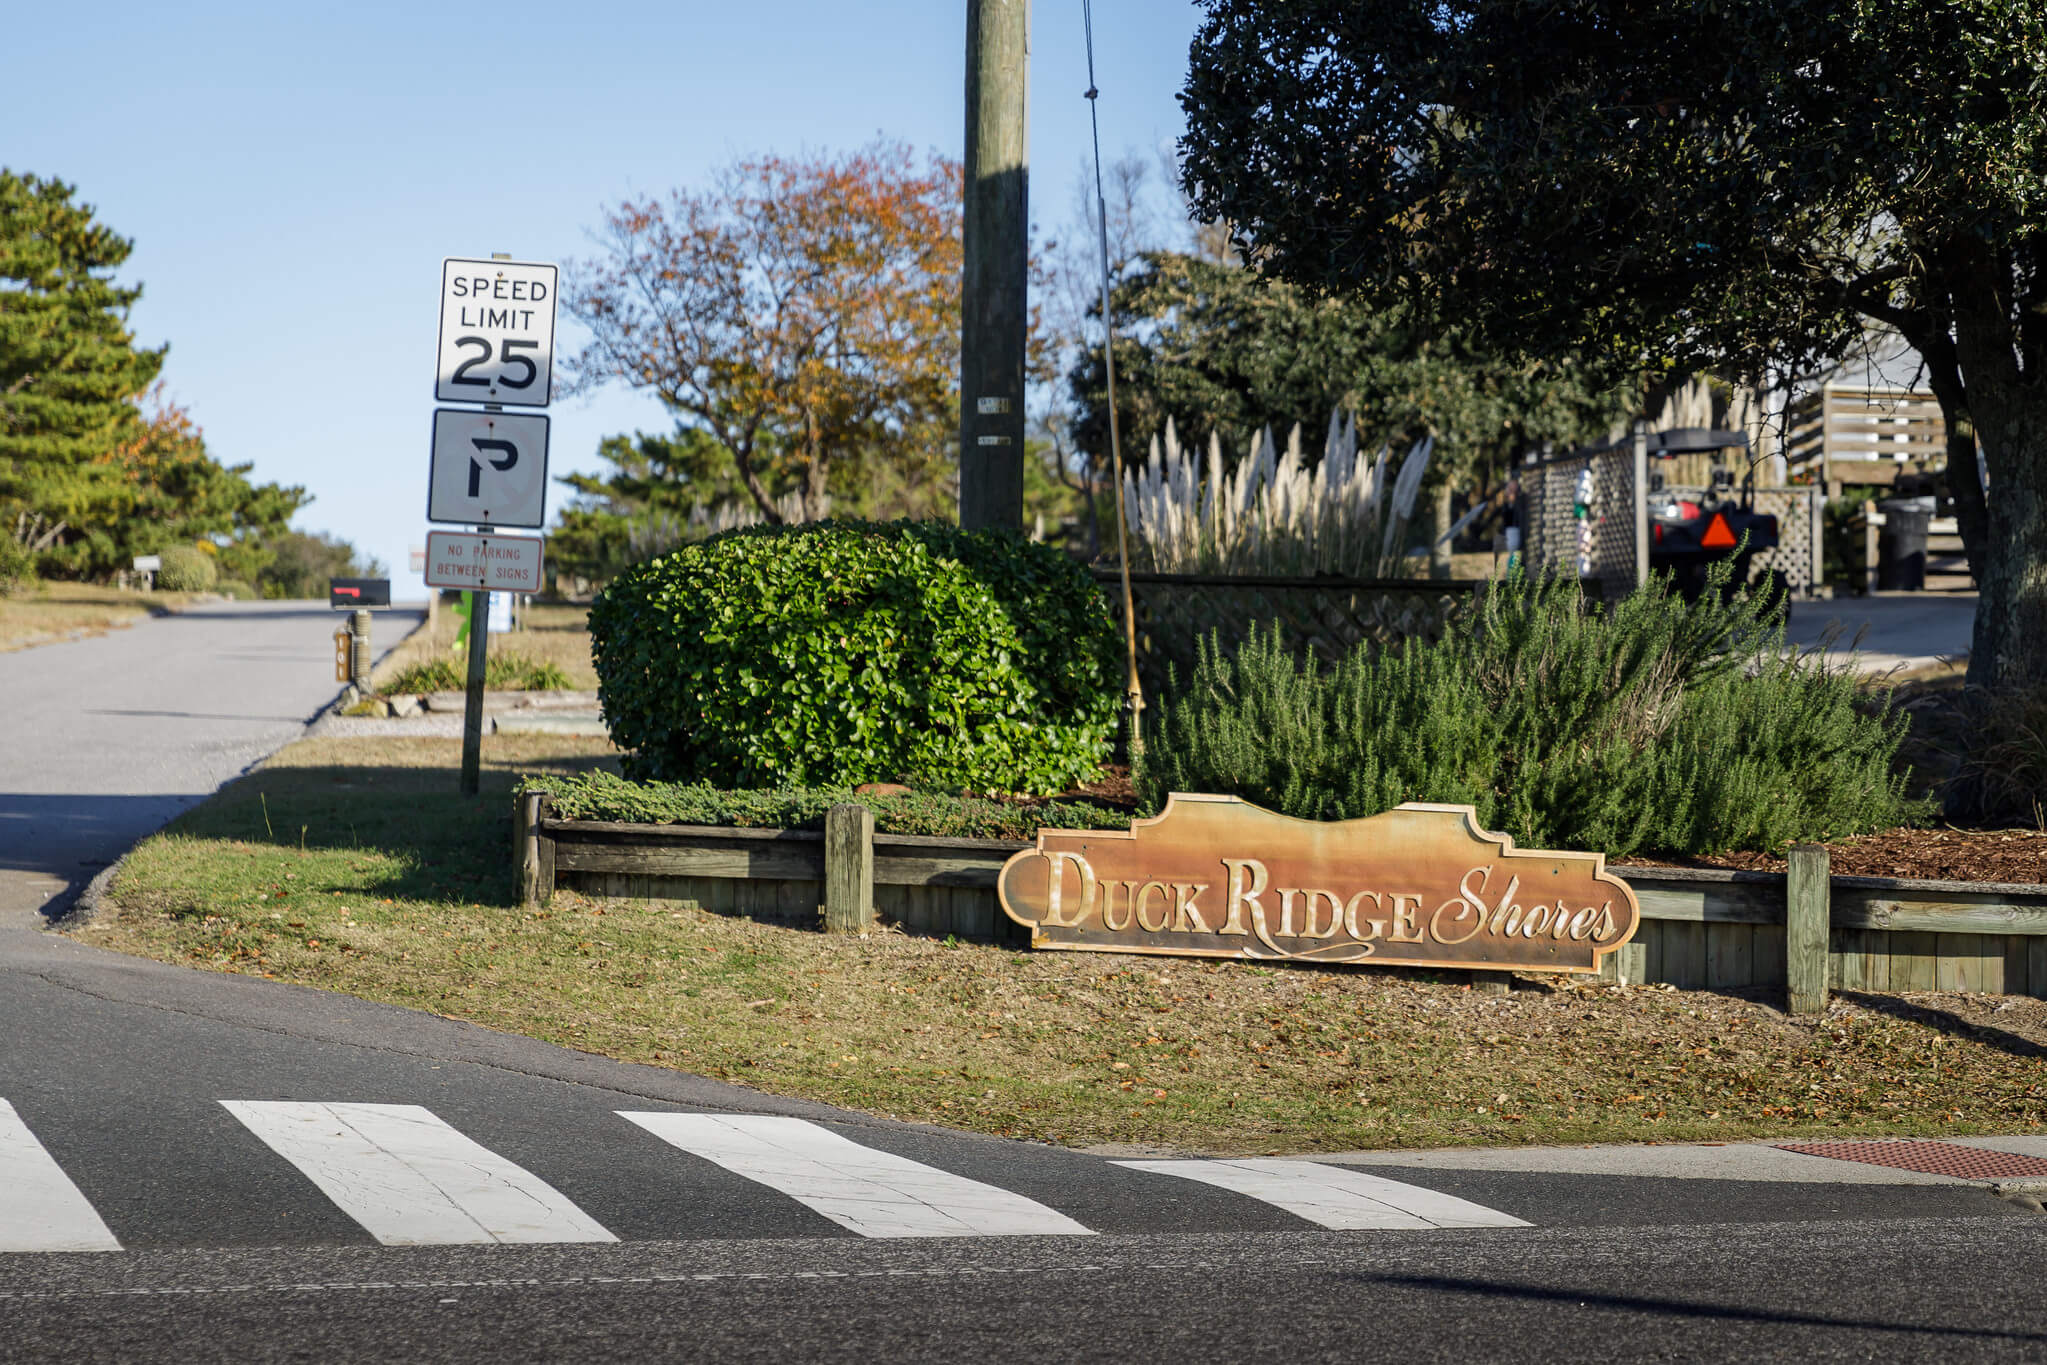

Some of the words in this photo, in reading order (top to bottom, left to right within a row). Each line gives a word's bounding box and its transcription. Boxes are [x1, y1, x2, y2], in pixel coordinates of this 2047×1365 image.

[452, 276, 547, 302] SPEED
[460, 305, 536, 331] LIMIT
[451, 335, 539, 390] 25
[447, 544, 463, 557] NO
[472, 545, 521, 561] PARKING
[436, 563, 488, 578] BETWEEN
[495, 567, 530, 580] SIGNS
[1429, 864, 1618, 945] Shores
